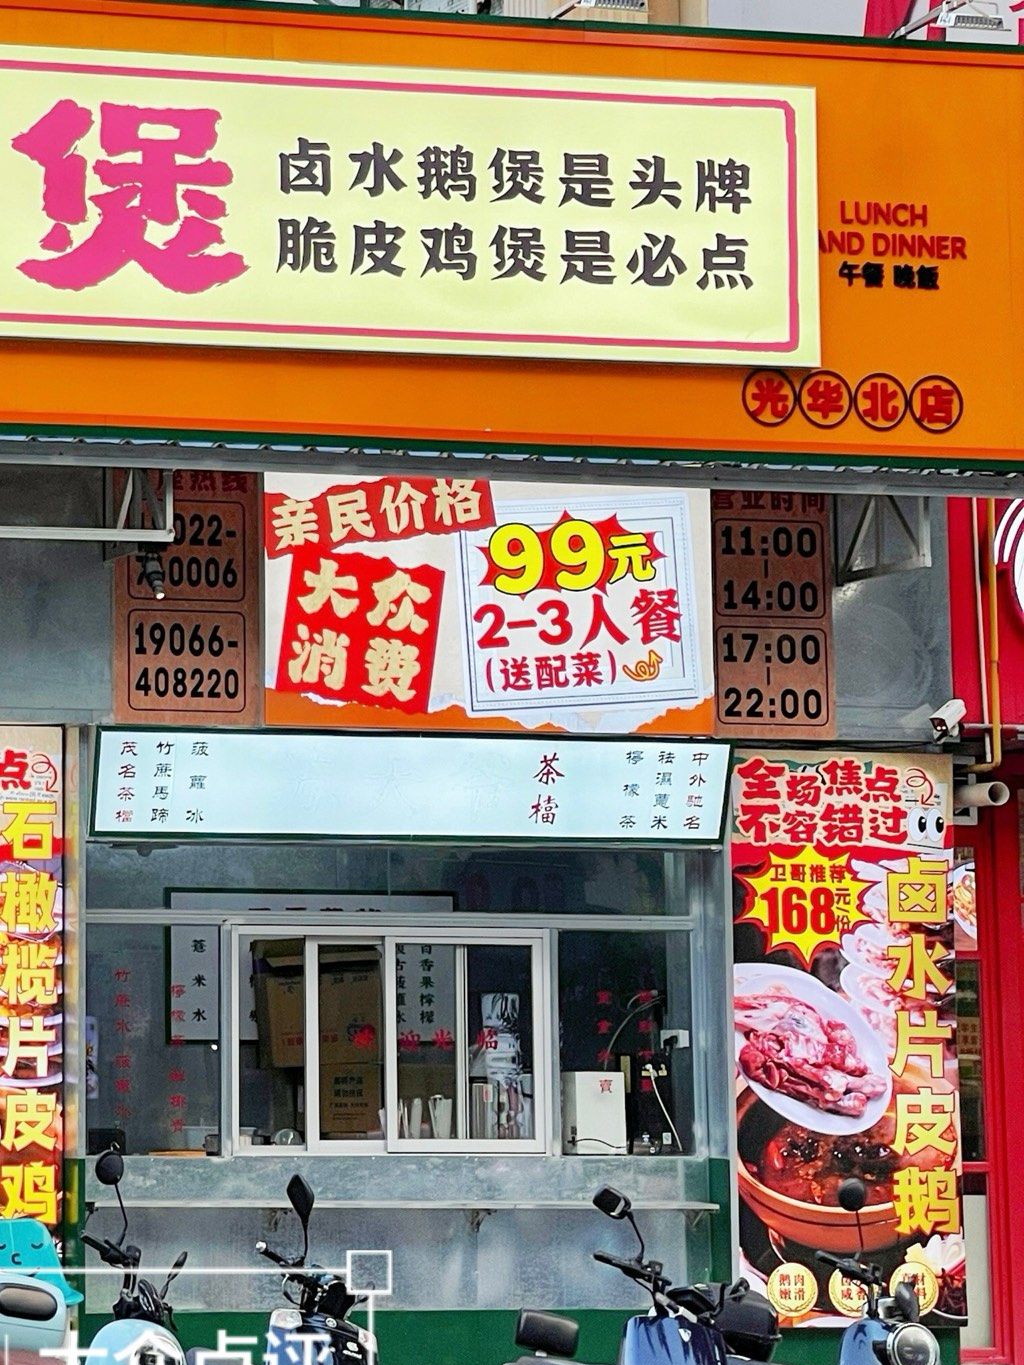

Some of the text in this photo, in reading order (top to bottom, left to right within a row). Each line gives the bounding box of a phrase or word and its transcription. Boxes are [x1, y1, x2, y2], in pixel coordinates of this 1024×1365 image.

[277, 137, 754, 215] 卤水鹅煲是头牌
[840, 200, 928, 227] LUNCH
[276, 217, 755, 291] 脆皮鸡煲是必点
[872, 232, 967, 260] DINNER
[751, 377, 955, 425] 光华北店
[272, 478, 482, 550] 亲民价格
[488, 518, 656, 596] 99元
[721, 526, 817, 558] 11:00
[298, 557, 432, 635] 大众
[473, 588, 682, 650] 2-3人餐
[722, 580, 819, 612] 14:00
[135, 622, 239, 657] 19066-
[287, 624, 421, 702] 消费
[722, 633, 821, 665] 17:00
[135, 667, 239, 699] 408220
[723, 688, 822, 719] 22:00
[737, 758, 902, 807] 全场焦点
[739, 803, 908, 843] 不容错过
[760, 886, 836, 935] 168
[0, 801, 58, 1225] 石橄榄片皮鸡
[885, 856, 960, 1234] 卤水片皮鹅
